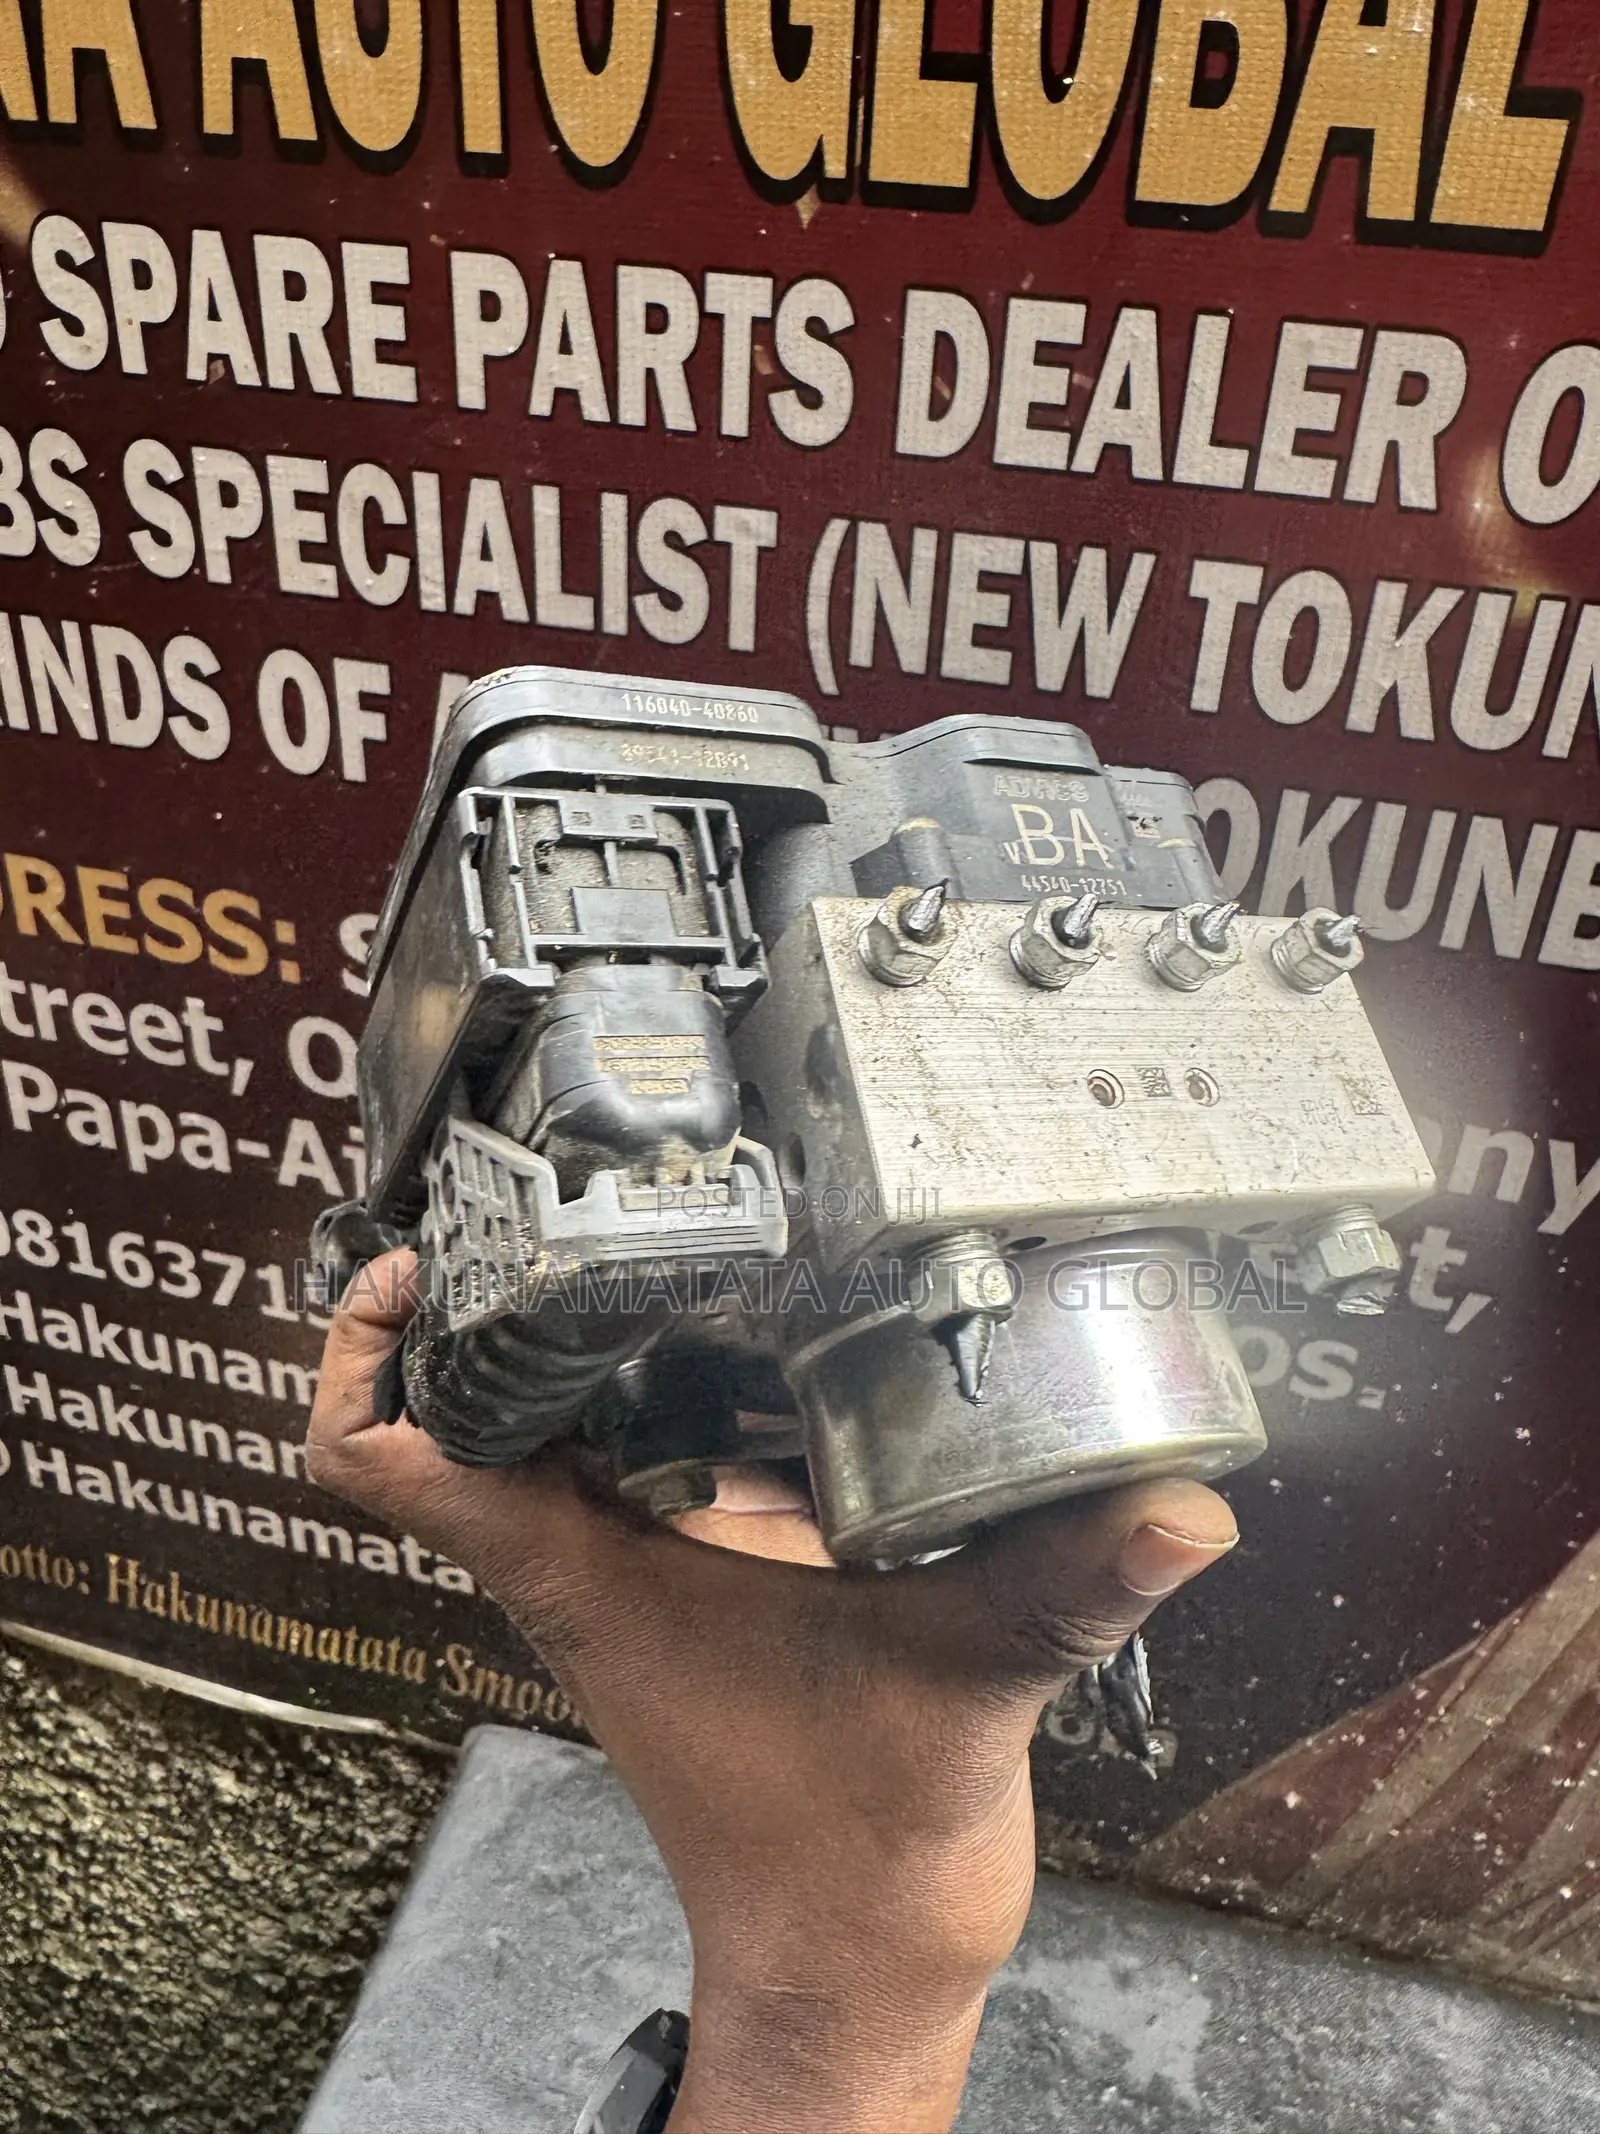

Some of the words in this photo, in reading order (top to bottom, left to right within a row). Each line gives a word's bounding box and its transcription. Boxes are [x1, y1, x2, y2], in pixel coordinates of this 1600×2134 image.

[30, 215, 417, 403] SPARE
[451, 251, 856, 450] PARTS
[895, 289, 1467, 511] DEALER
[122, 438, 778, 652] SPECIALIST
[806, 518, 1157, 699] (NEW
[258, 649, 391, 782] OF
[1421, 1116, 1600, 1236] ny
[0, 1208, 332, 1331] 816371
[21, 1440, 500, 1603] Hakunamata
[105, 1552, 429, 1686] Hakunamatata
[440, 1642, 582, 1728] Smoo
